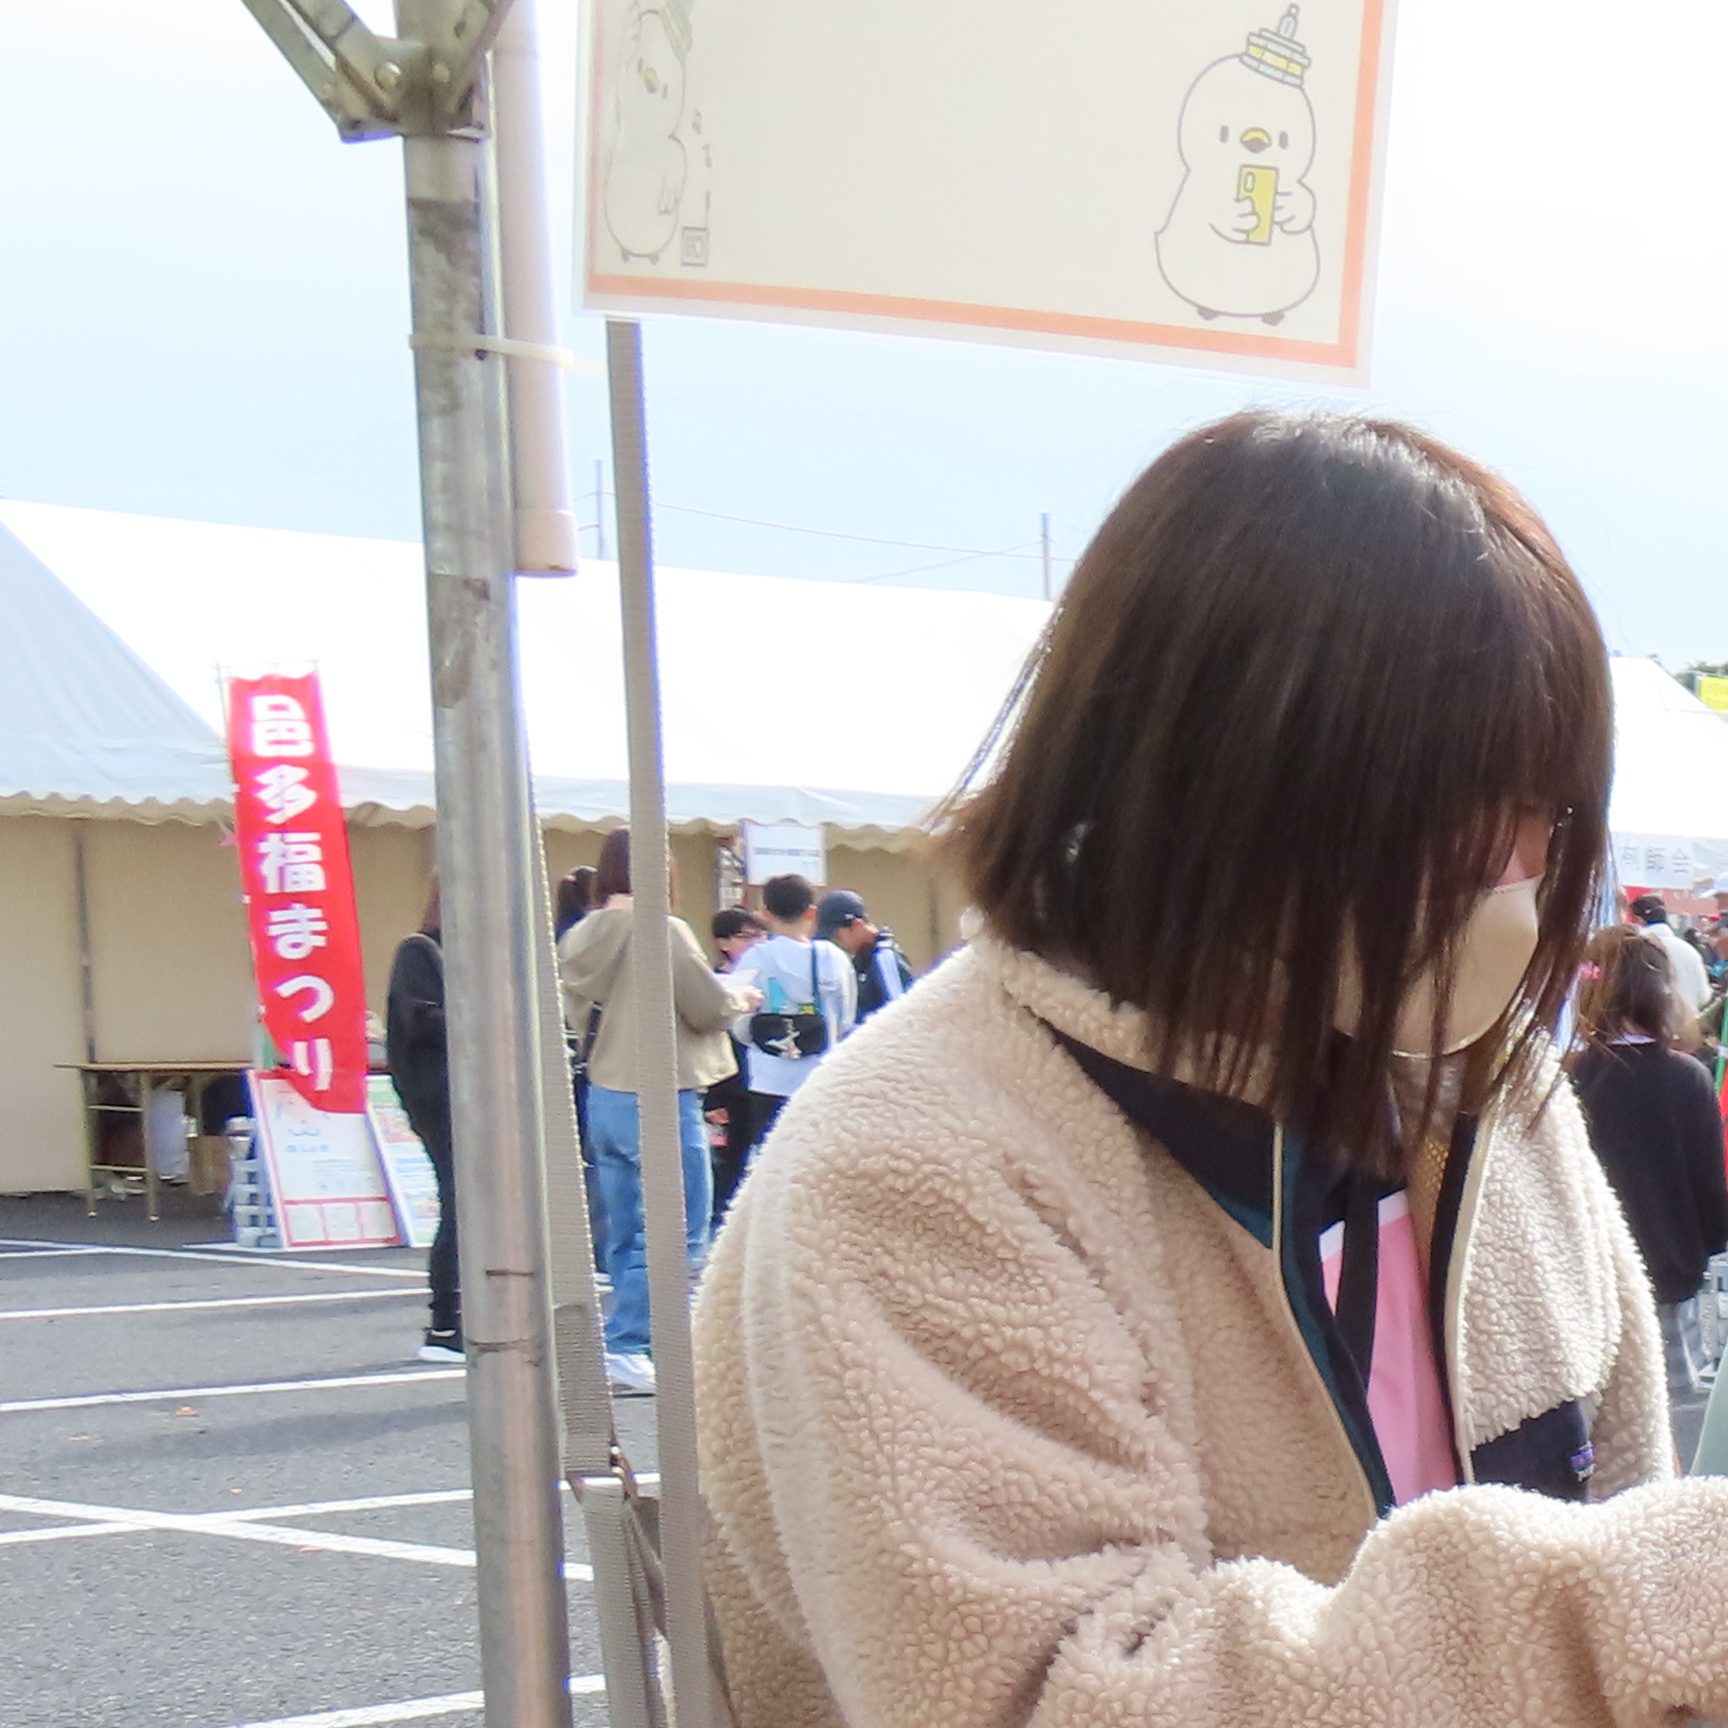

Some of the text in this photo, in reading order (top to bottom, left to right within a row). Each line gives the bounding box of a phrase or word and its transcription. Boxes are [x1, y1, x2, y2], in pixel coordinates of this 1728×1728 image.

[251, 693, 335, 1091] 邑多福まつり
